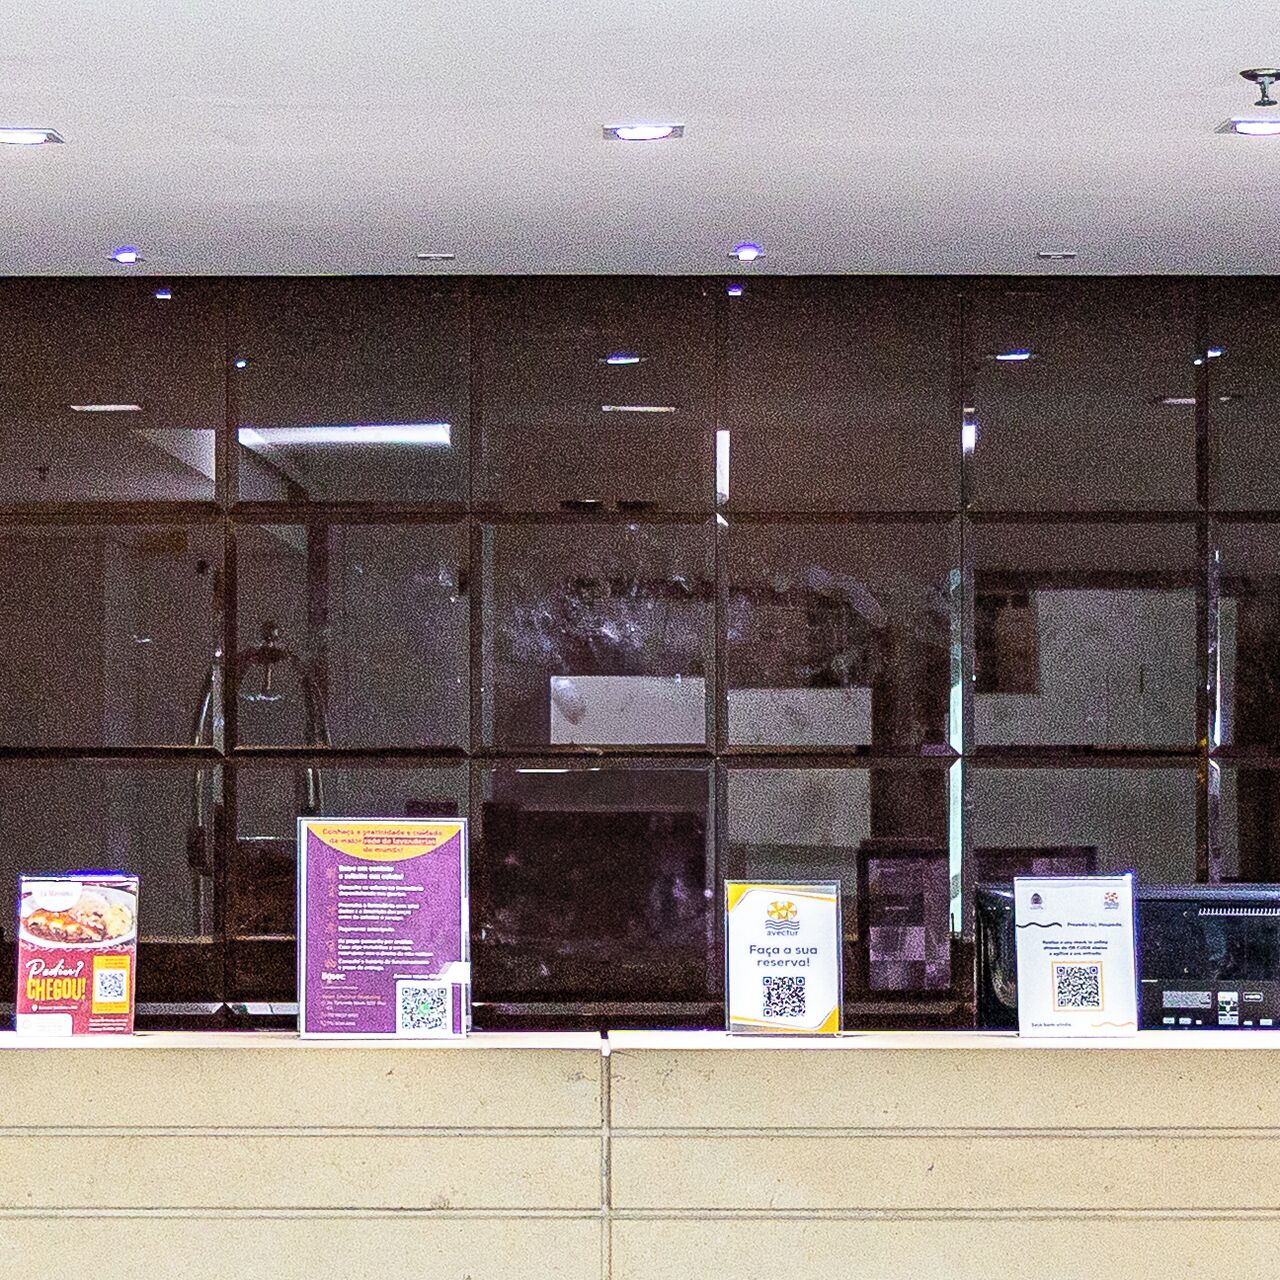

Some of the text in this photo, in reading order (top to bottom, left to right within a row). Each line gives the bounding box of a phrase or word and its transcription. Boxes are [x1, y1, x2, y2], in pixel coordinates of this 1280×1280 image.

[766, 929, 799, 937] avectur
[749, 944, 780, 957] Faça
[795, 947, 818, 955] sua
[757, 957, 810, 967] reserva!
[27, 977, 87, 1001] CHEGOU!
